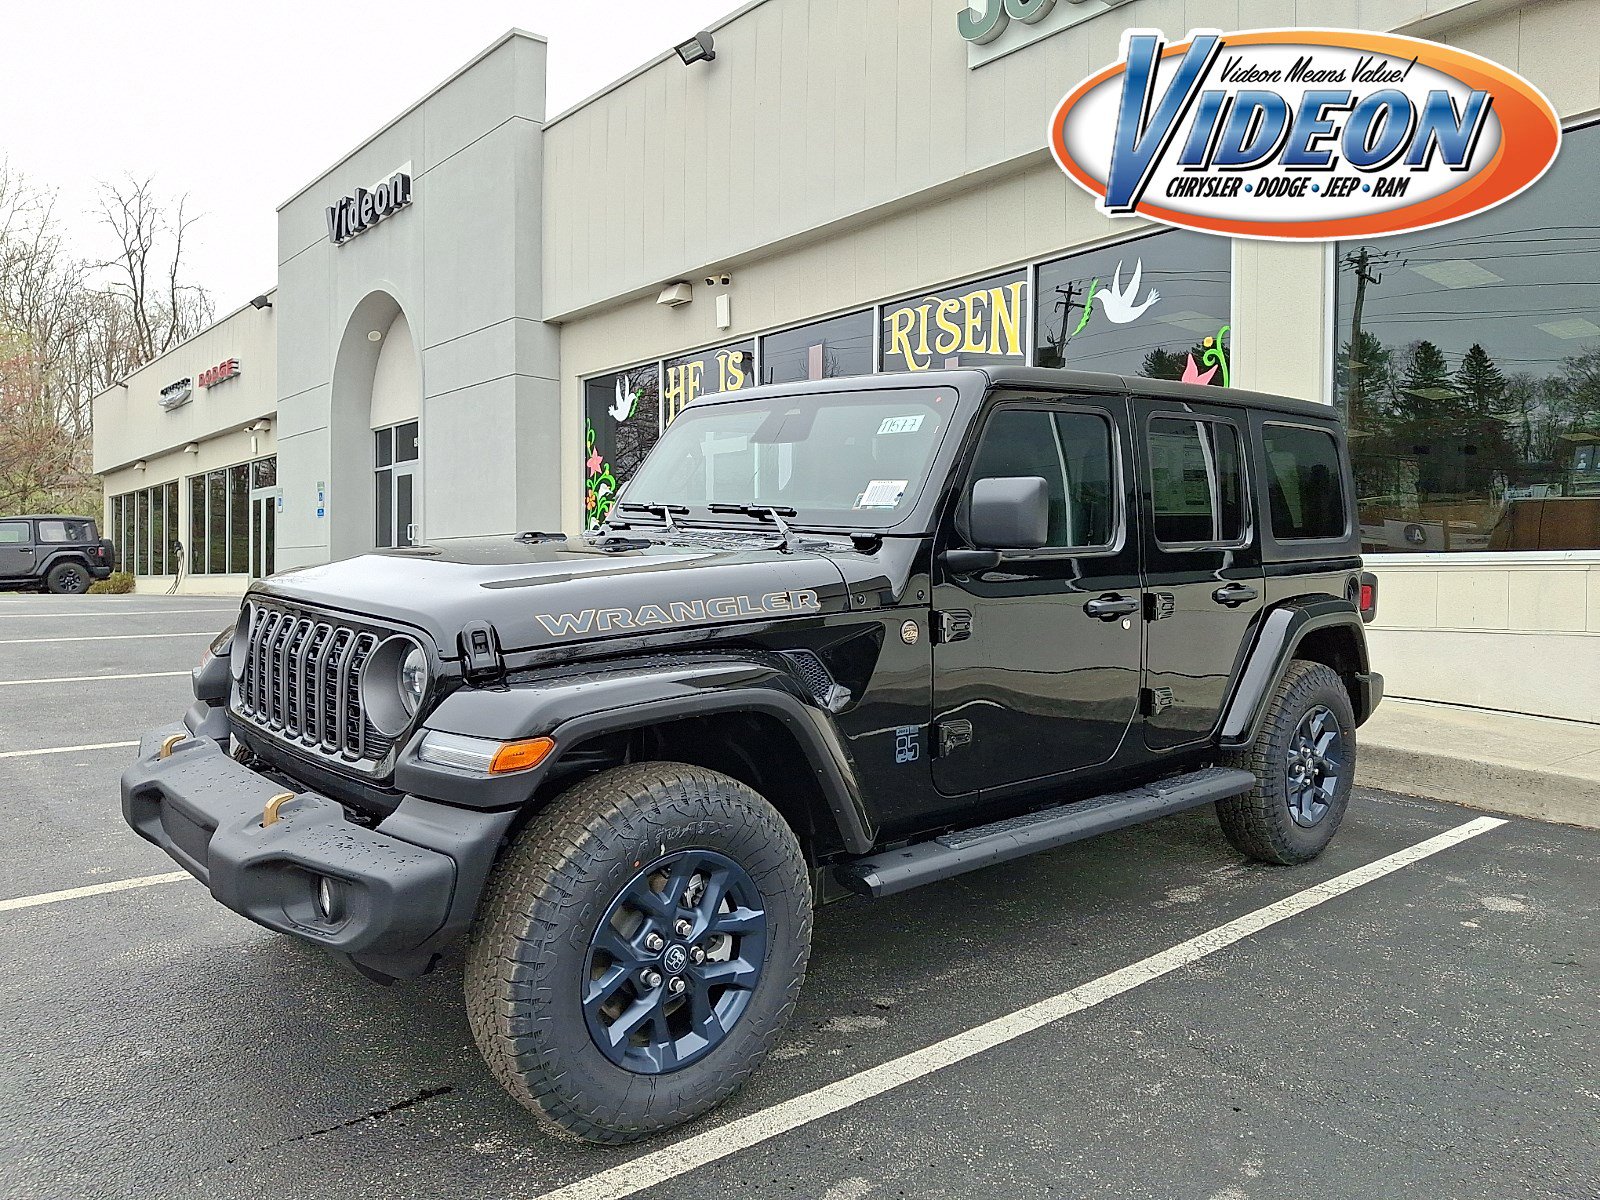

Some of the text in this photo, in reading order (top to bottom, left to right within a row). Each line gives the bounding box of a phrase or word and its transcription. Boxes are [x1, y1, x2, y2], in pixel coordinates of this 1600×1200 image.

[325, 172, 411, 244] Videon
[714, 349, 745, 392] IS
[883, 281, 1028, 371] RISEN
[198, 357, 239, 388] DODGE
[535, 589, 822, 636] WRANGLER
[895, 734, 919, 764] 85
